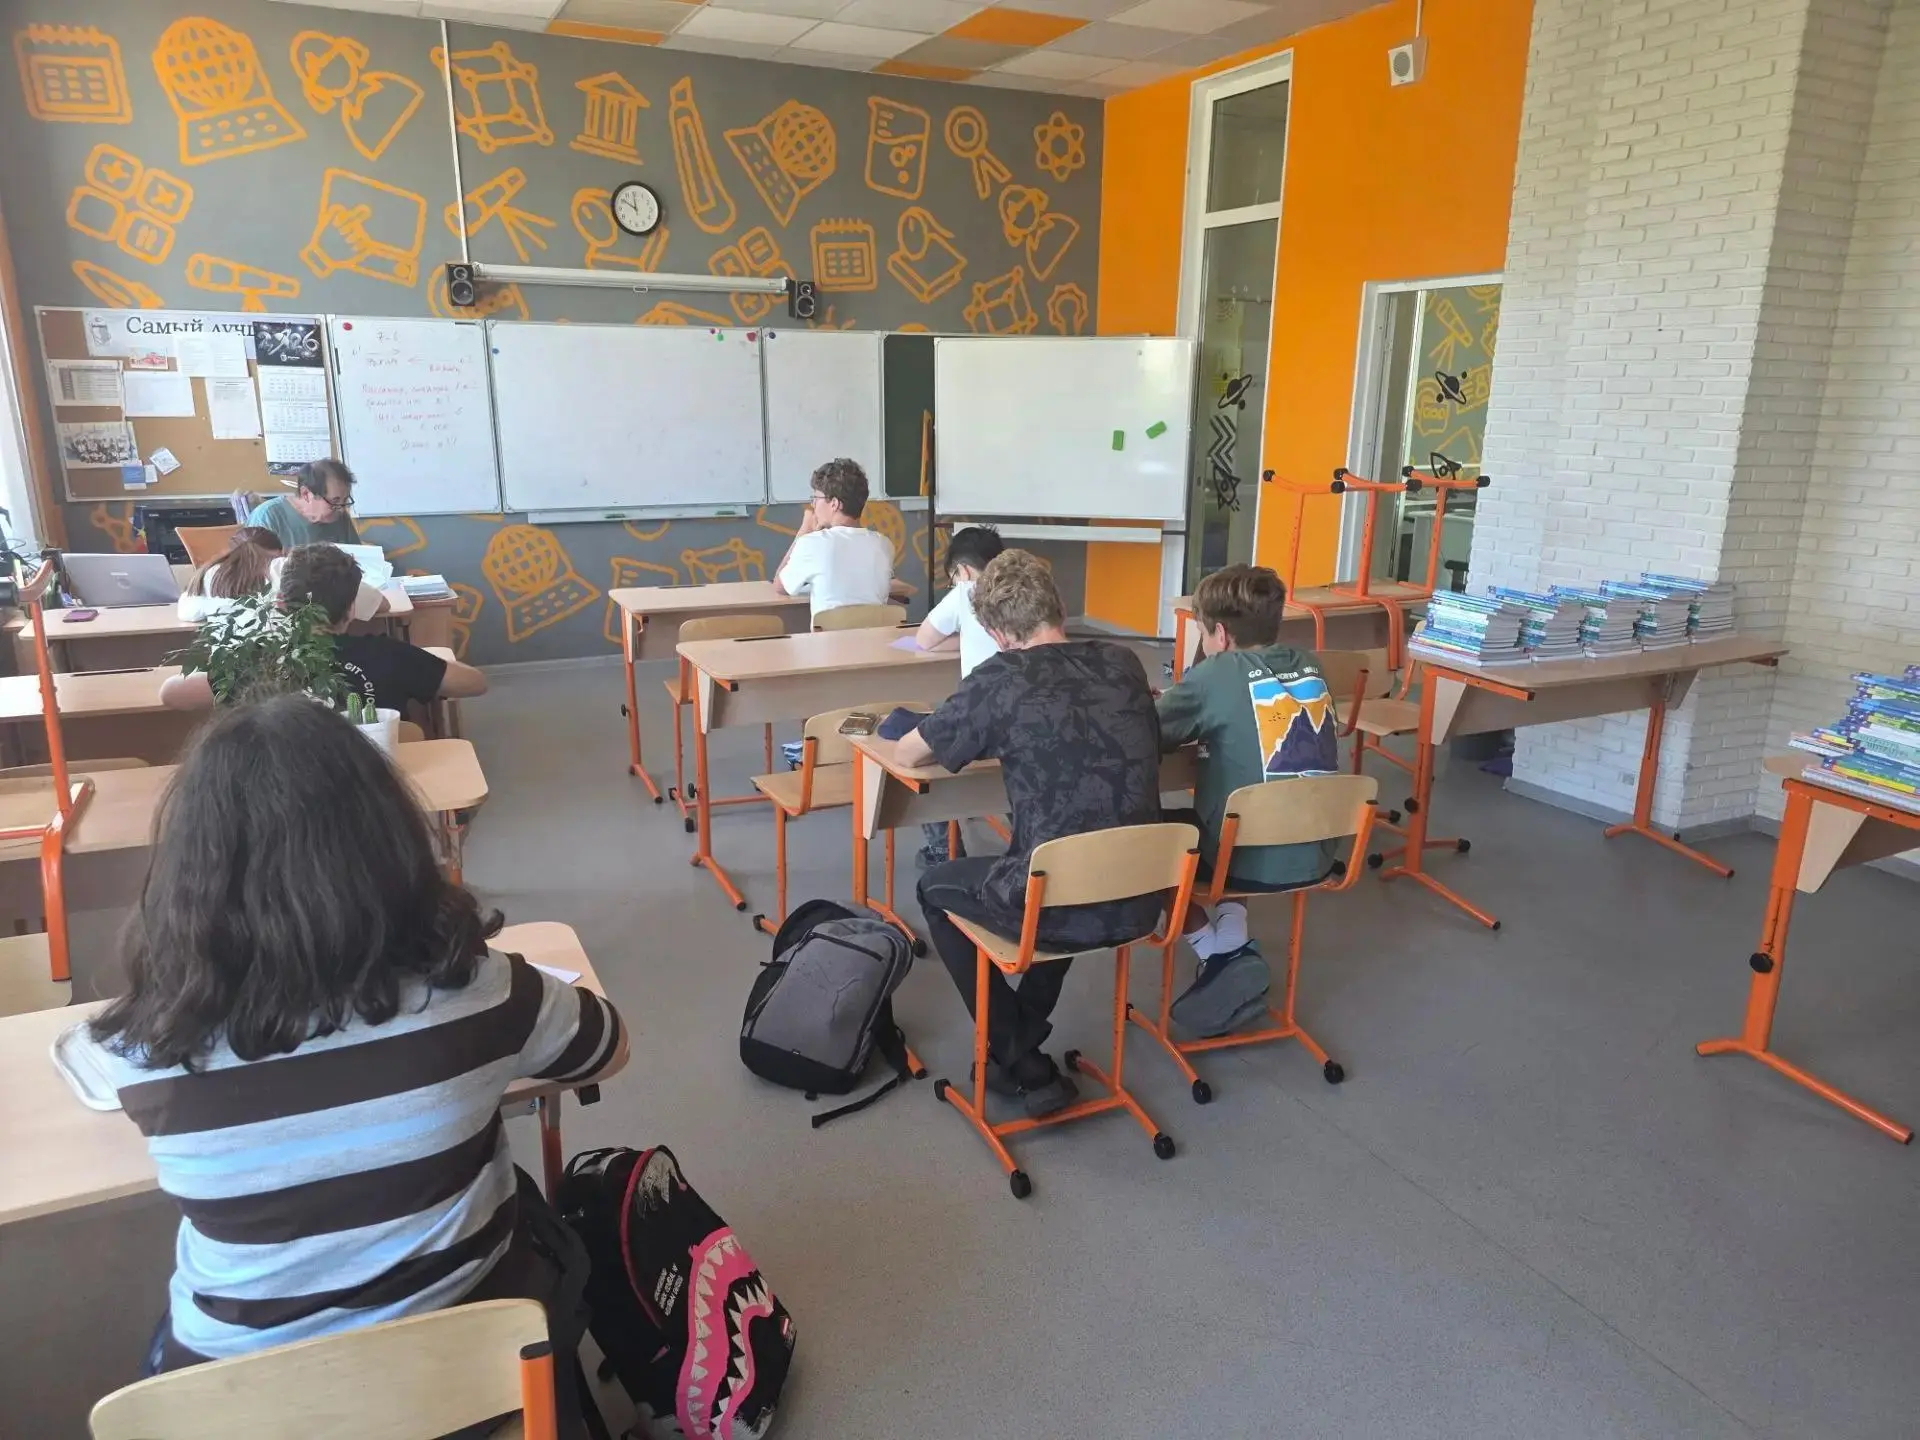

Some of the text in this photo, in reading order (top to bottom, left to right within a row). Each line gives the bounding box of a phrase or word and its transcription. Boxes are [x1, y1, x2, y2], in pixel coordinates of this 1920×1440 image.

[126, 316, 204, 334] Самый
[344, 662, 363, 674] GIT
[1248, 669, 1262, 678] GO
